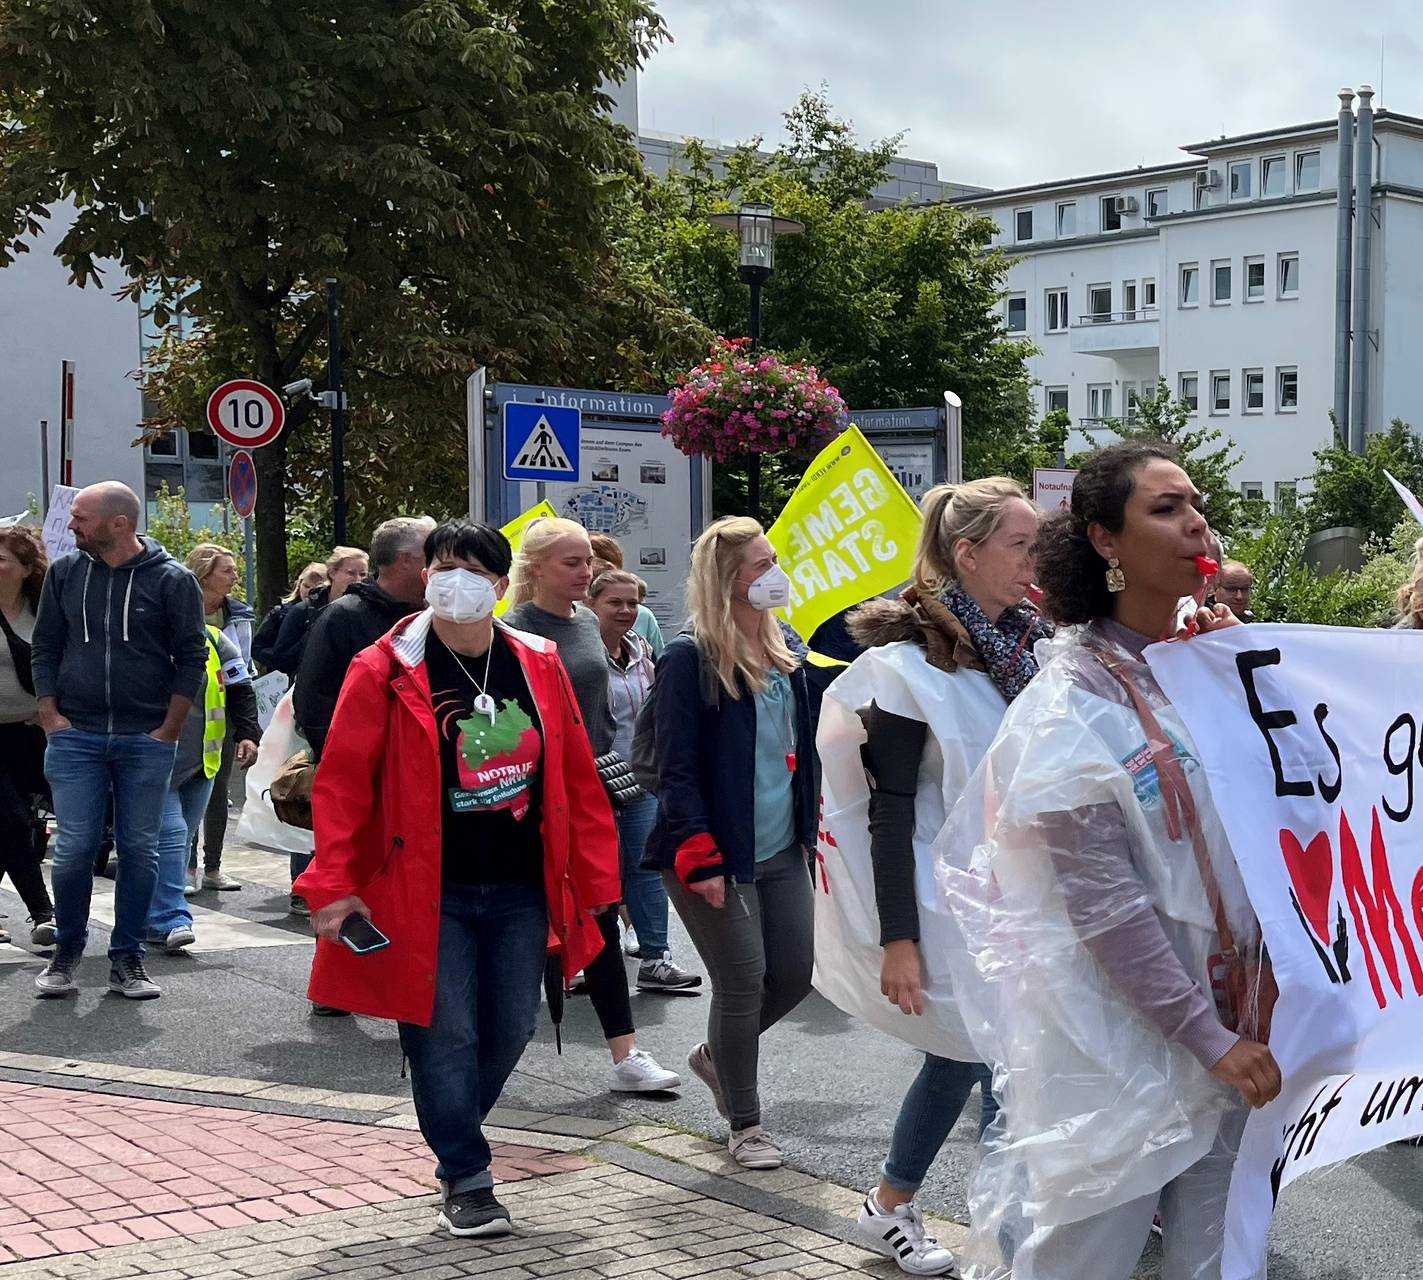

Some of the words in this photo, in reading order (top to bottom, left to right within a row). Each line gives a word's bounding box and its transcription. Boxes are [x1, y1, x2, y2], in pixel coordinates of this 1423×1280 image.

[228, 399, 263, 429] 10
[541, 391, 654, 414] Information
[1236, 648, 1342, 803] Es
[477, 761, 533, 783] NOTRUF
[455, 798, 478, 808] stark
